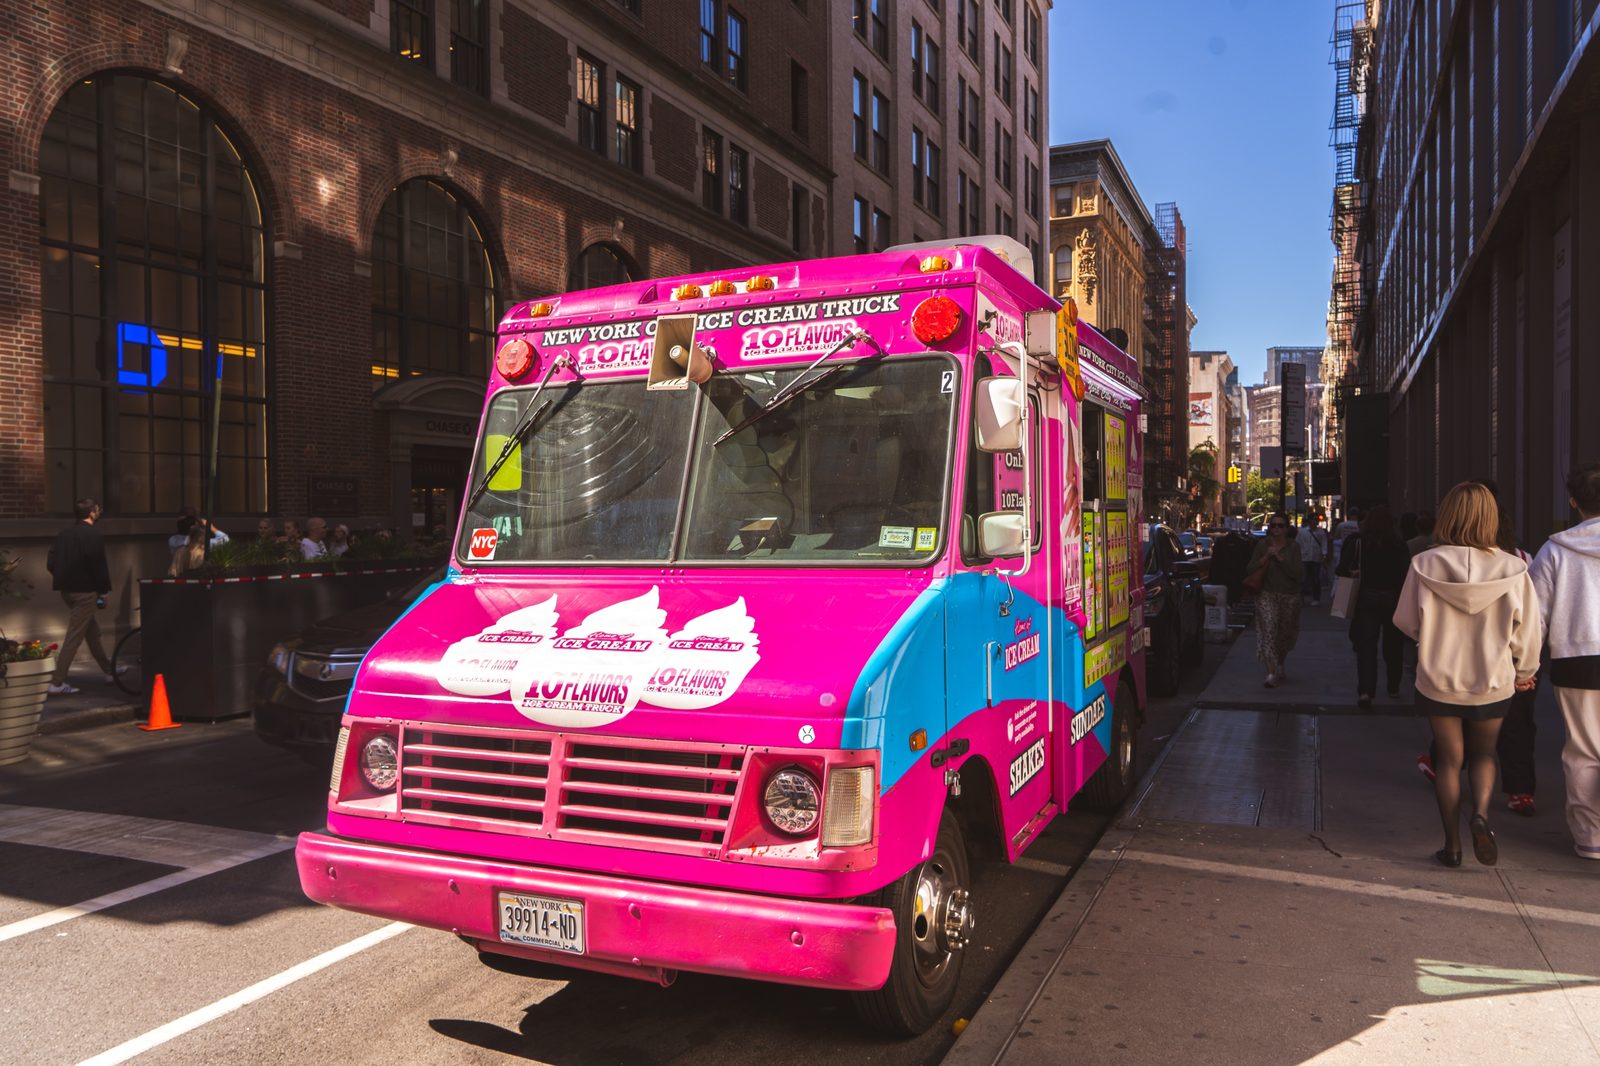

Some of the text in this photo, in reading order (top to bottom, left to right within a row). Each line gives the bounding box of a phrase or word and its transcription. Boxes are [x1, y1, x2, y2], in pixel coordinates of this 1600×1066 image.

[543, 328, 587, 346] NEW
[587, 322, 643, 342] YORK
[697, 312, 733, 331] ICE
[738, 303, 818, 325] CREAM
[823, 294, 901, 318] TRUCK
[745, 322, 854, 350] 10 FLAVORS
[581, 345, 619, 365] 10
[1079, 345, 1092, 360] NEW
[943, 372, 953, 392] 2
[427, 420, 462, 433] CHASE
[1006, 452, 1023, 468] Onl
[471, 535, 497, 549] NYC
[482, 634, 541, 644] ICE CREAM
[554, 639, 651, 651] ICE CREAM
[670, 641, 743, 651] ICE CREAM
[1005, 633, 1040, 670] ICE CREAM
[647, 667, 730, 690] 10 FLAVORS
[525, 673, 632, 704] 10 FLAVORS
[523, 699, 624, 714] ICE CREAM TRUCK
[1071, 694, 1105, 746] SUNDAES
[1010, 737, 1045, 797] SHAKES
[520, 897, 561, 911] NEW YORK
[522, 935, 561, 947] COMMERCIAL
